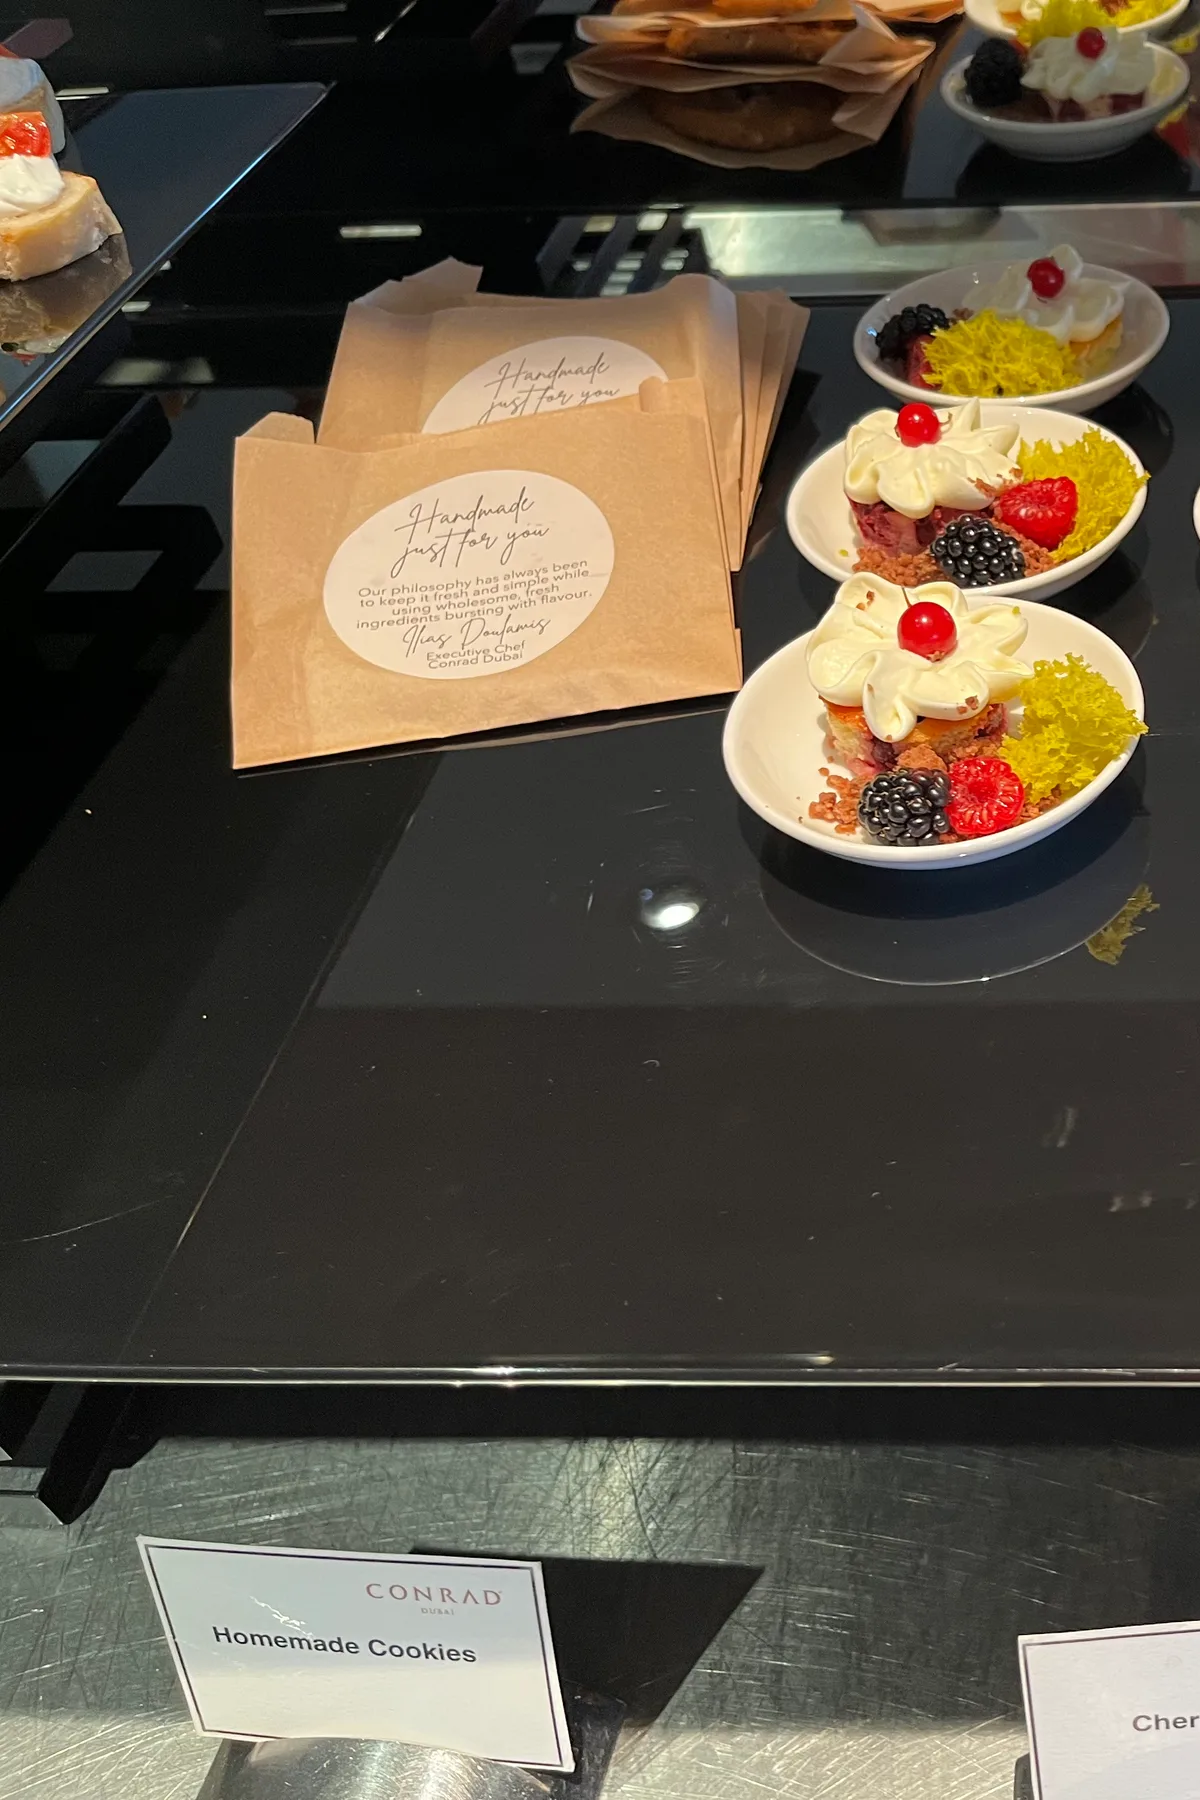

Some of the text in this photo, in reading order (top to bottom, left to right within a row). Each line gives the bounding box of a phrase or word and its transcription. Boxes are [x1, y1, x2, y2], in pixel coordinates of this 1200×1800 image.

[484, 352, 610, 399] Handmade
[477, 385, 538, 425] just
[534, 386, 575, 415] for
[394, 486, 535, 545] Handmade
[390, 527, 550, 579] just for you
[358, 560, 588, 598] Our philosophy has always been
[360, 569, 589, 608] to keep it fresh and simple while
[356, 590, 592, 631] ingredients bursting with flavour.
[392, 584, 560, 616] using wholesome, fresh
[426, 640, 526, 662] Executive Chef
[428, 651, 523, 670] Conrad Dubai
[366, 1583, 502, 1606] CONRAD
[212, 1625, 477, 1663] Homemade Cookies
